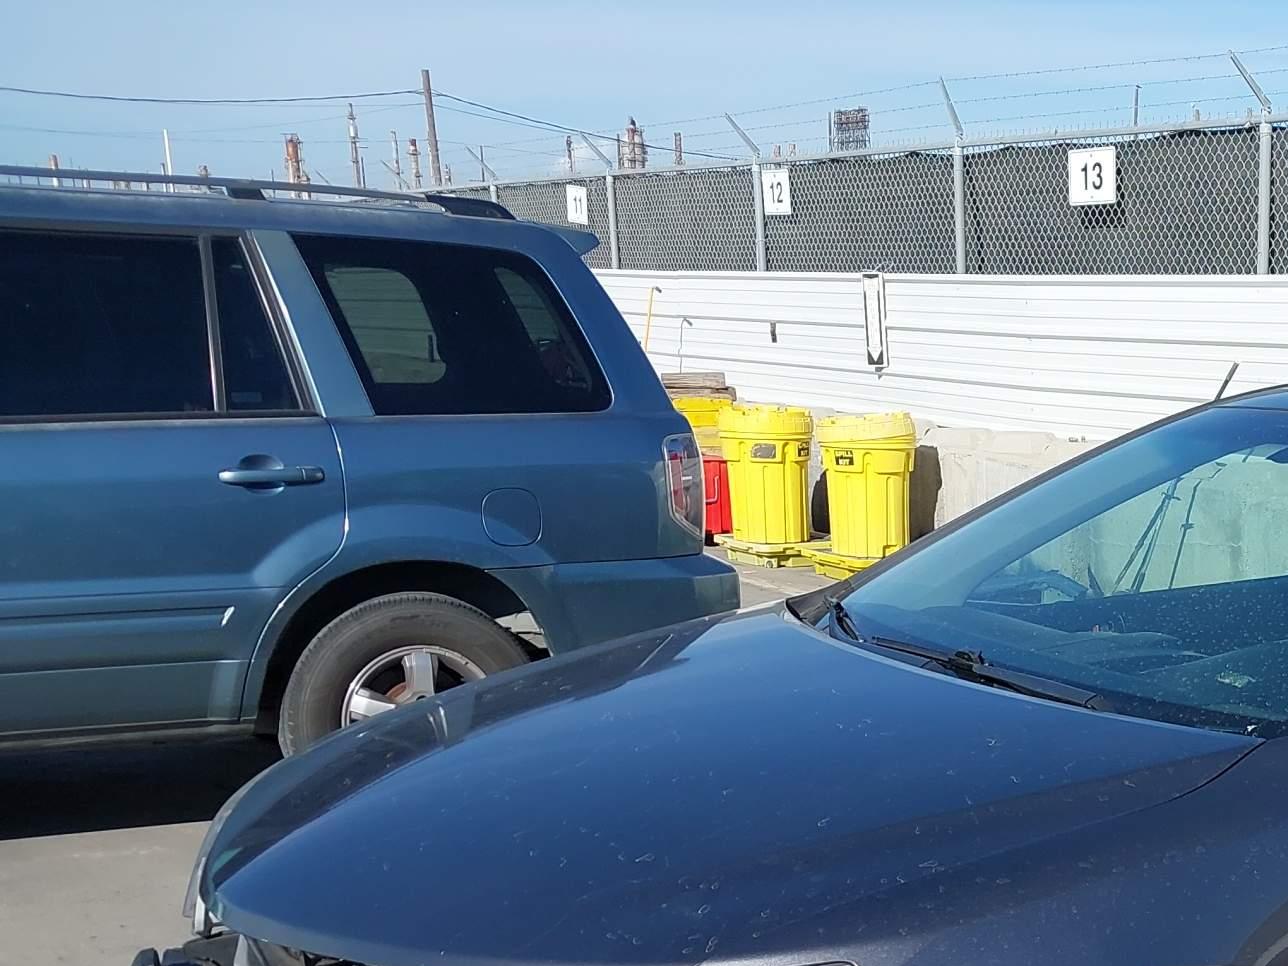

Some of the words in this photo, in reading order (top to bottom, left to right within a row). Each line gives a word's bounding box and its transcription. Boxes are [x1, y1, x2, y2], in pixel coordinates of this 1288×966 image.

[1081, 162, 1103, 190] 13
[769, 181, 783, 204] 12
[573, 196, 583, 215] 11
[838, 458, 850, 466] KIT
